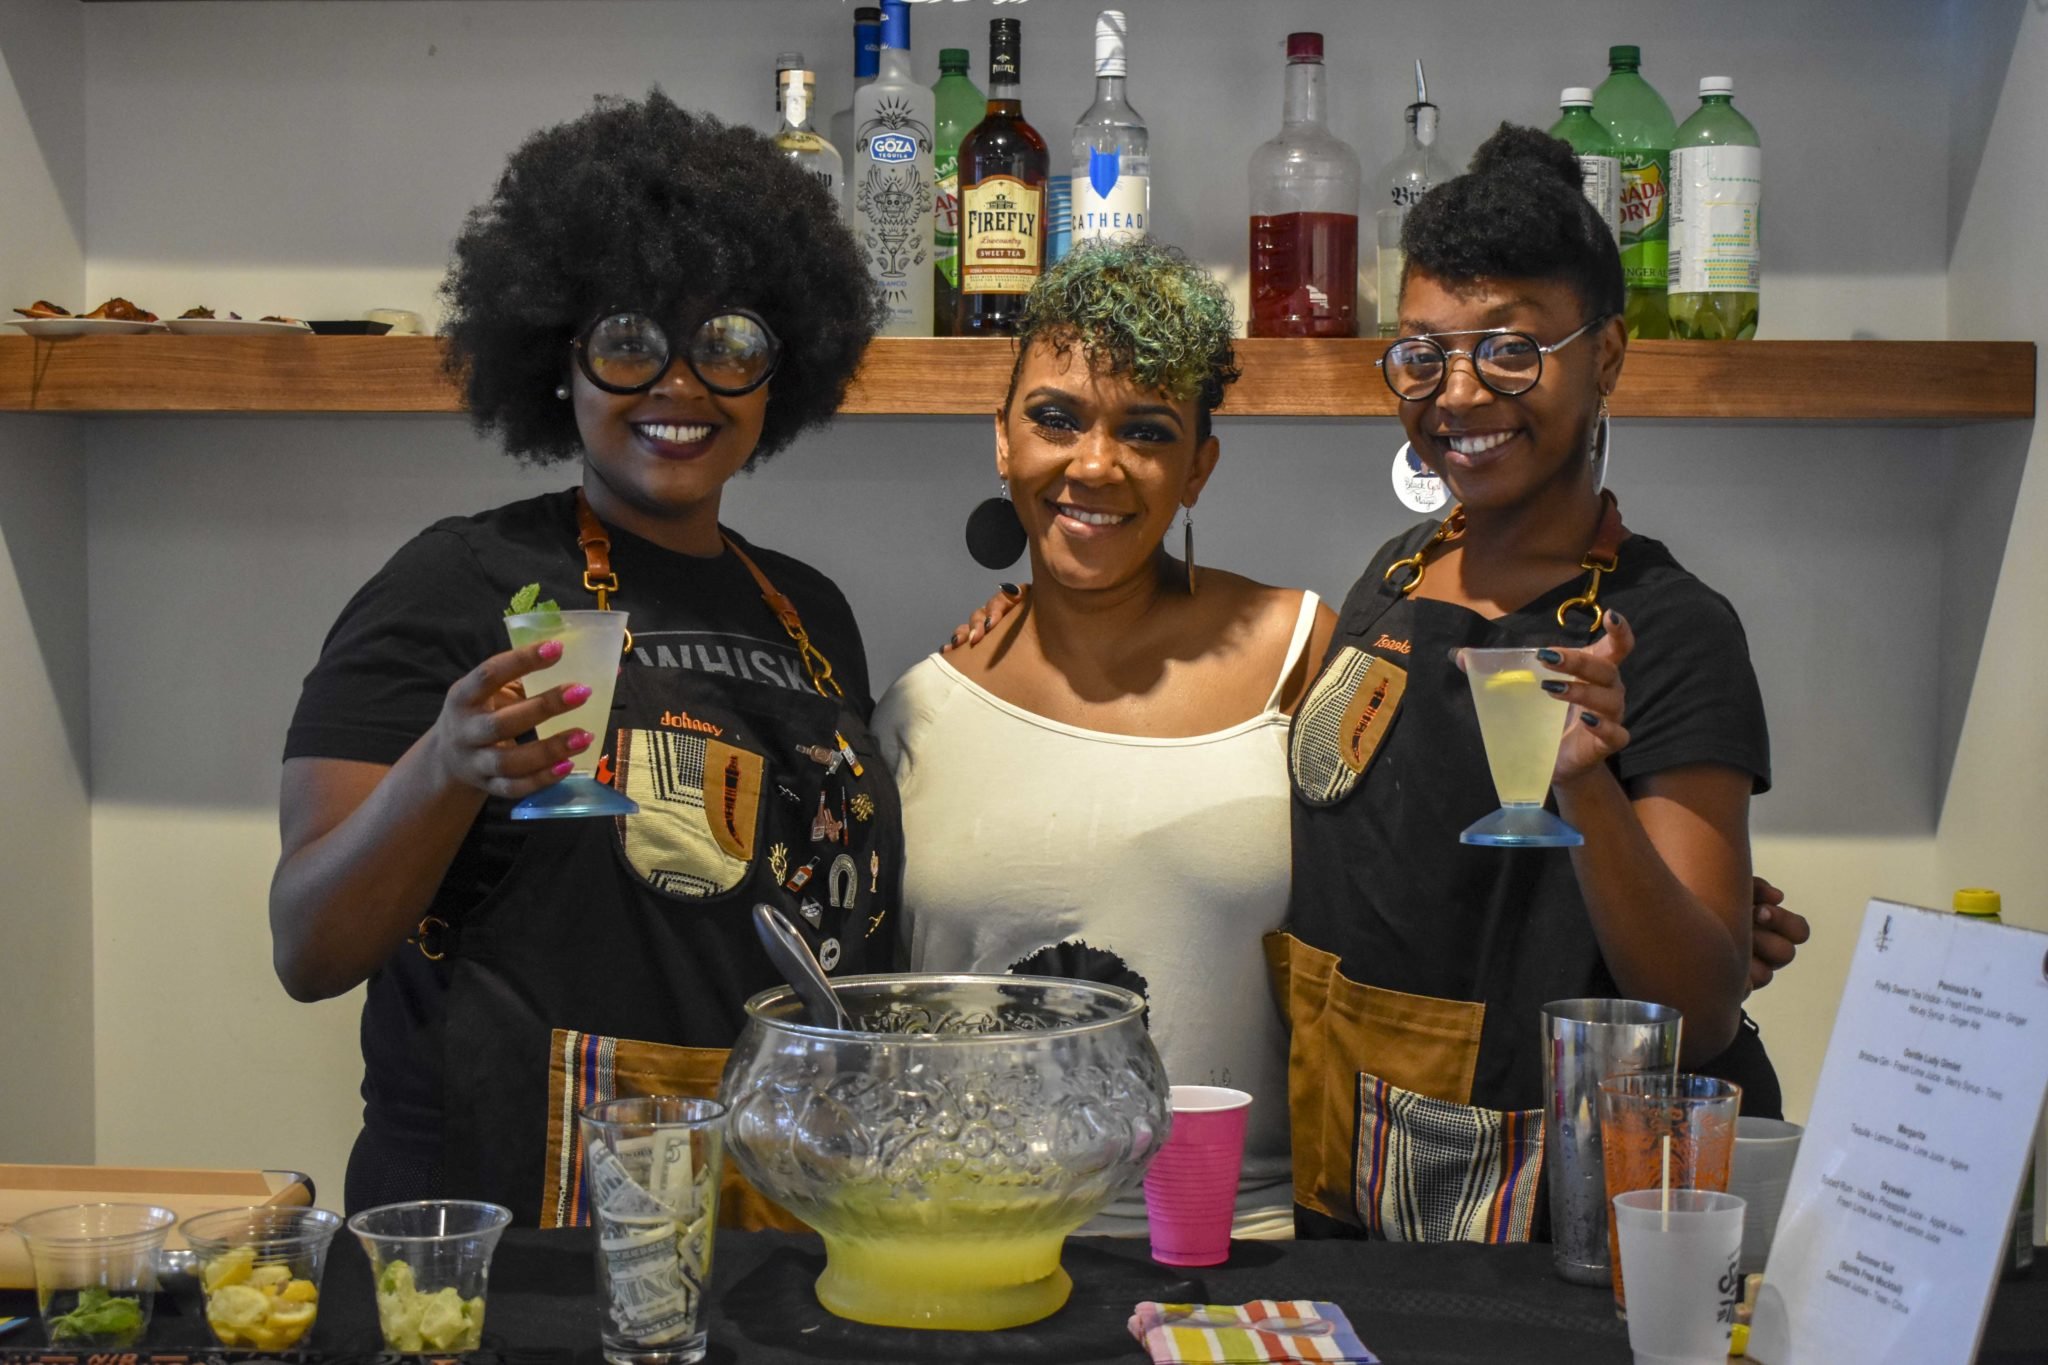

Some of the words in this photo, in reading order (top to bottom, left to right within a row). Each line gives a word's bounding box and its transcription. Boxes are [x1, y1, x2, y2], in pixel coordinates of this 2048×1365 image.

[874, 141, 912, 153] GOZA
[1620, 180, 1665, 204] NADA
[968, 210, 1036, 239] FIREFLY
[1072, 212, 1143, 229] CATHEAD
[980, 250, 1004, 258] SWEET
[1007, 250, 1021, 258] TEA
[660, 710, 724, 737] Johnny
[665, 1138, 680, 1163] 5
